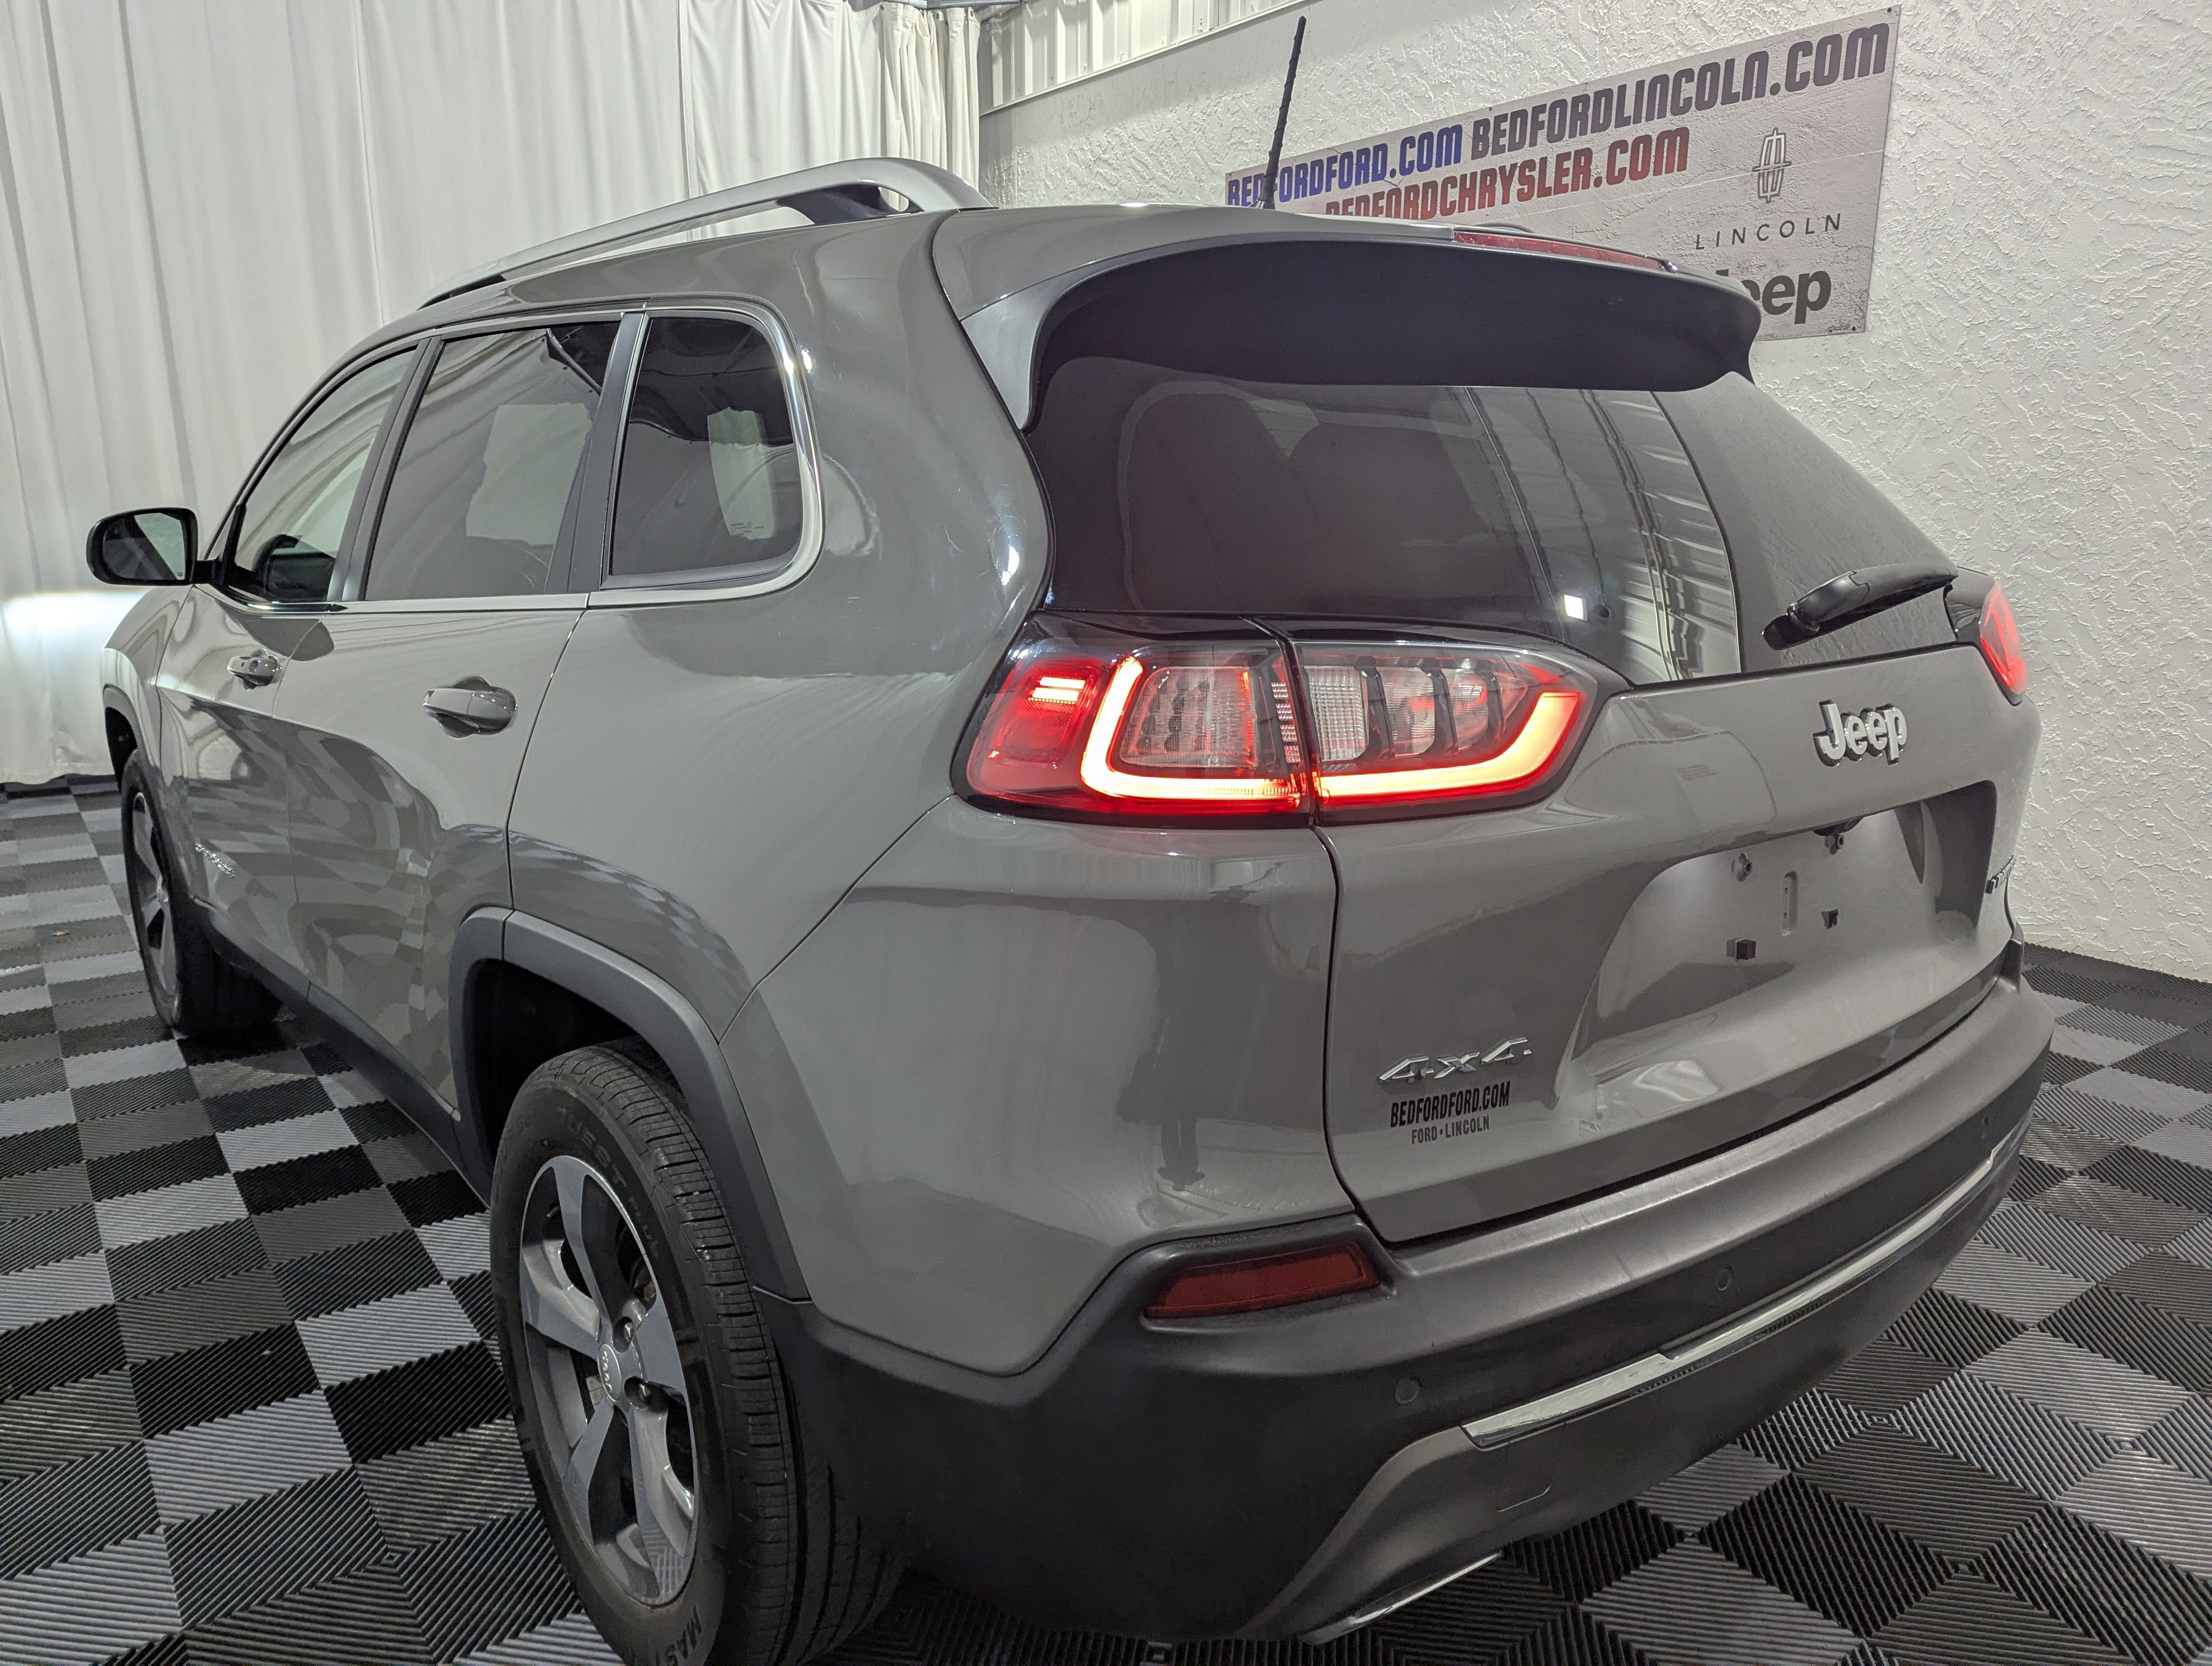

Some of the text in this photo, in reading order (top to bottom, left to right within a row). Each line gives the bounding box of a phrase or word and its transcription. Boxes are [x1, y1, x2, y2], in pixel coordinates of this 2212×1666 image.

[1227, 23, 1889, 206] BEDORDFORD.COM BEDFORDLINCOLN.COM
[1696, 213, 1841, 250] LINCOLN
[1715, 268, 1831, 324] ep
[1813, 699, 1907, 767] Jeep
[1378, 1036, 1532, 1083] 4x4
[1390, 1081, 1510, 1127] BEDFORDFORD.COM
